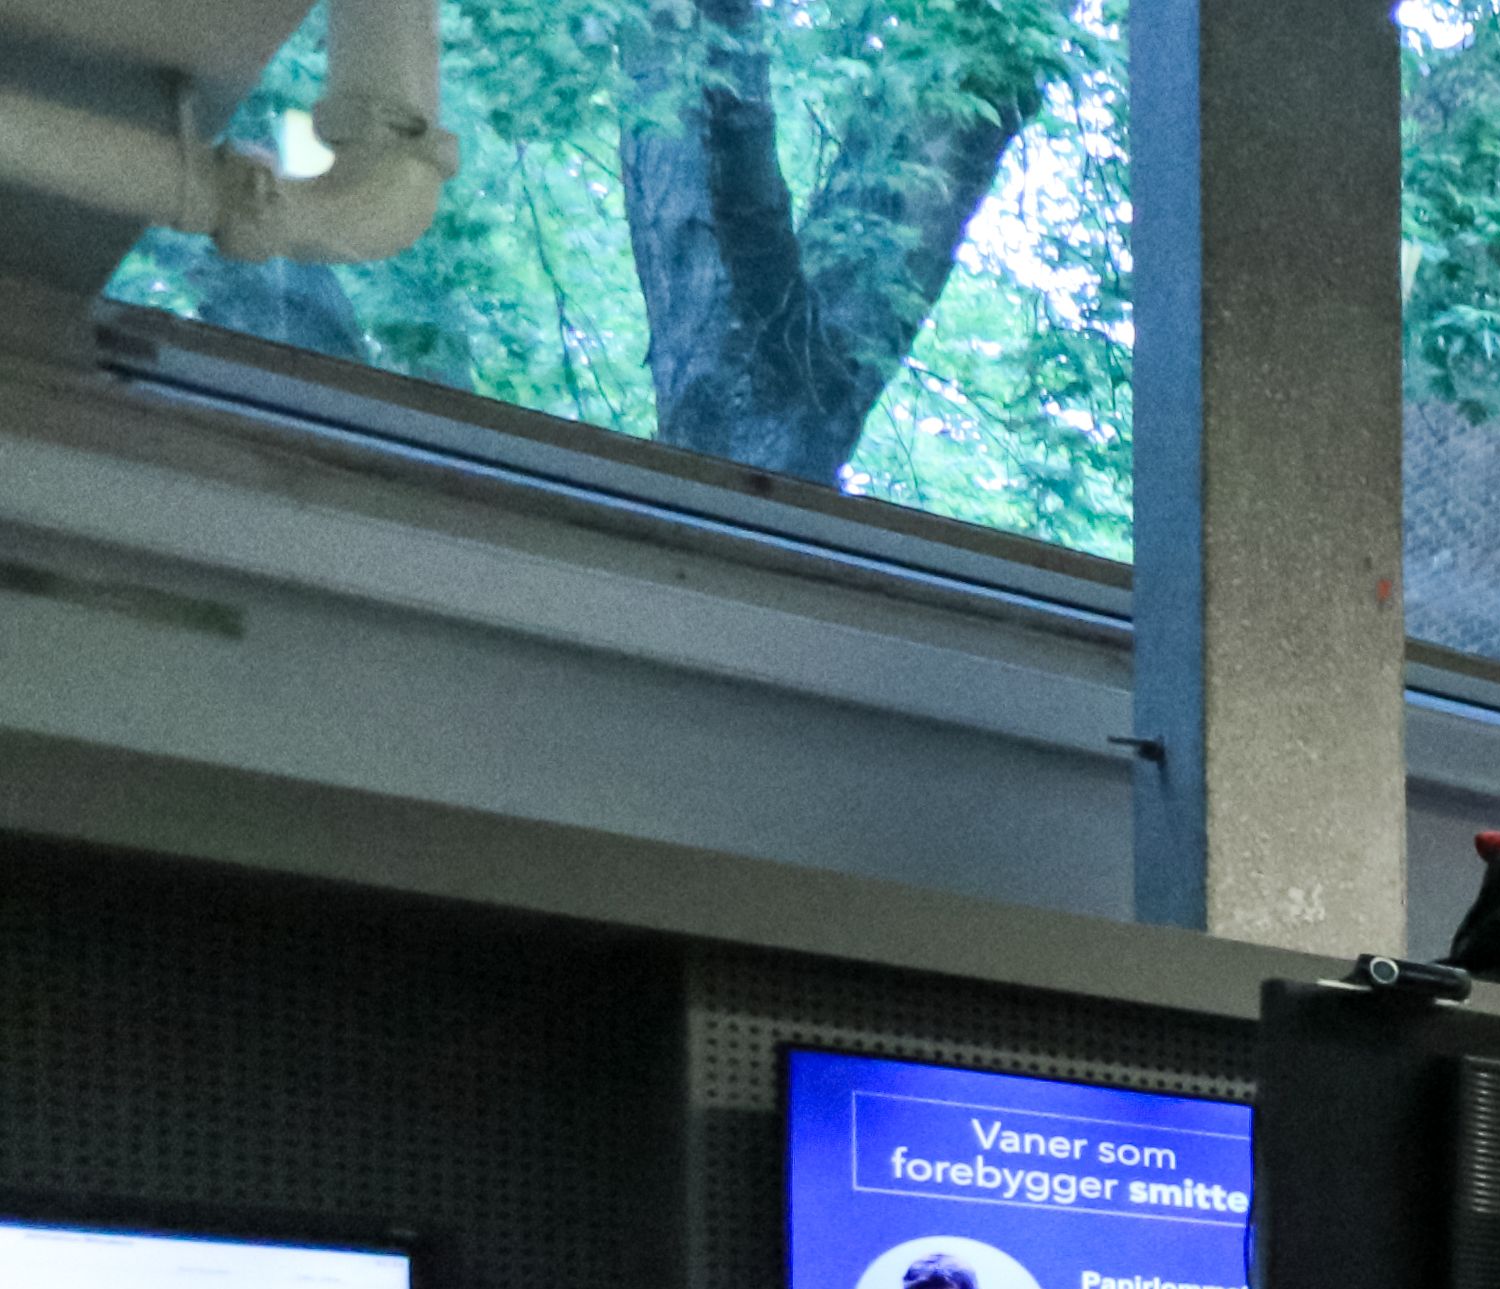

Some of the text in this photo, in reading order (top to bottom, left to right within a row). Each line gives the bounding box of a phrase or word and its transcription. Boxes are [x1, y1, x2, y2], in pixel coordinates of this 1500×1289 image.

[971, 1118, 1176, 1170] Vaner som
[891, 1146, 1249, 1213] forebygger smitte
